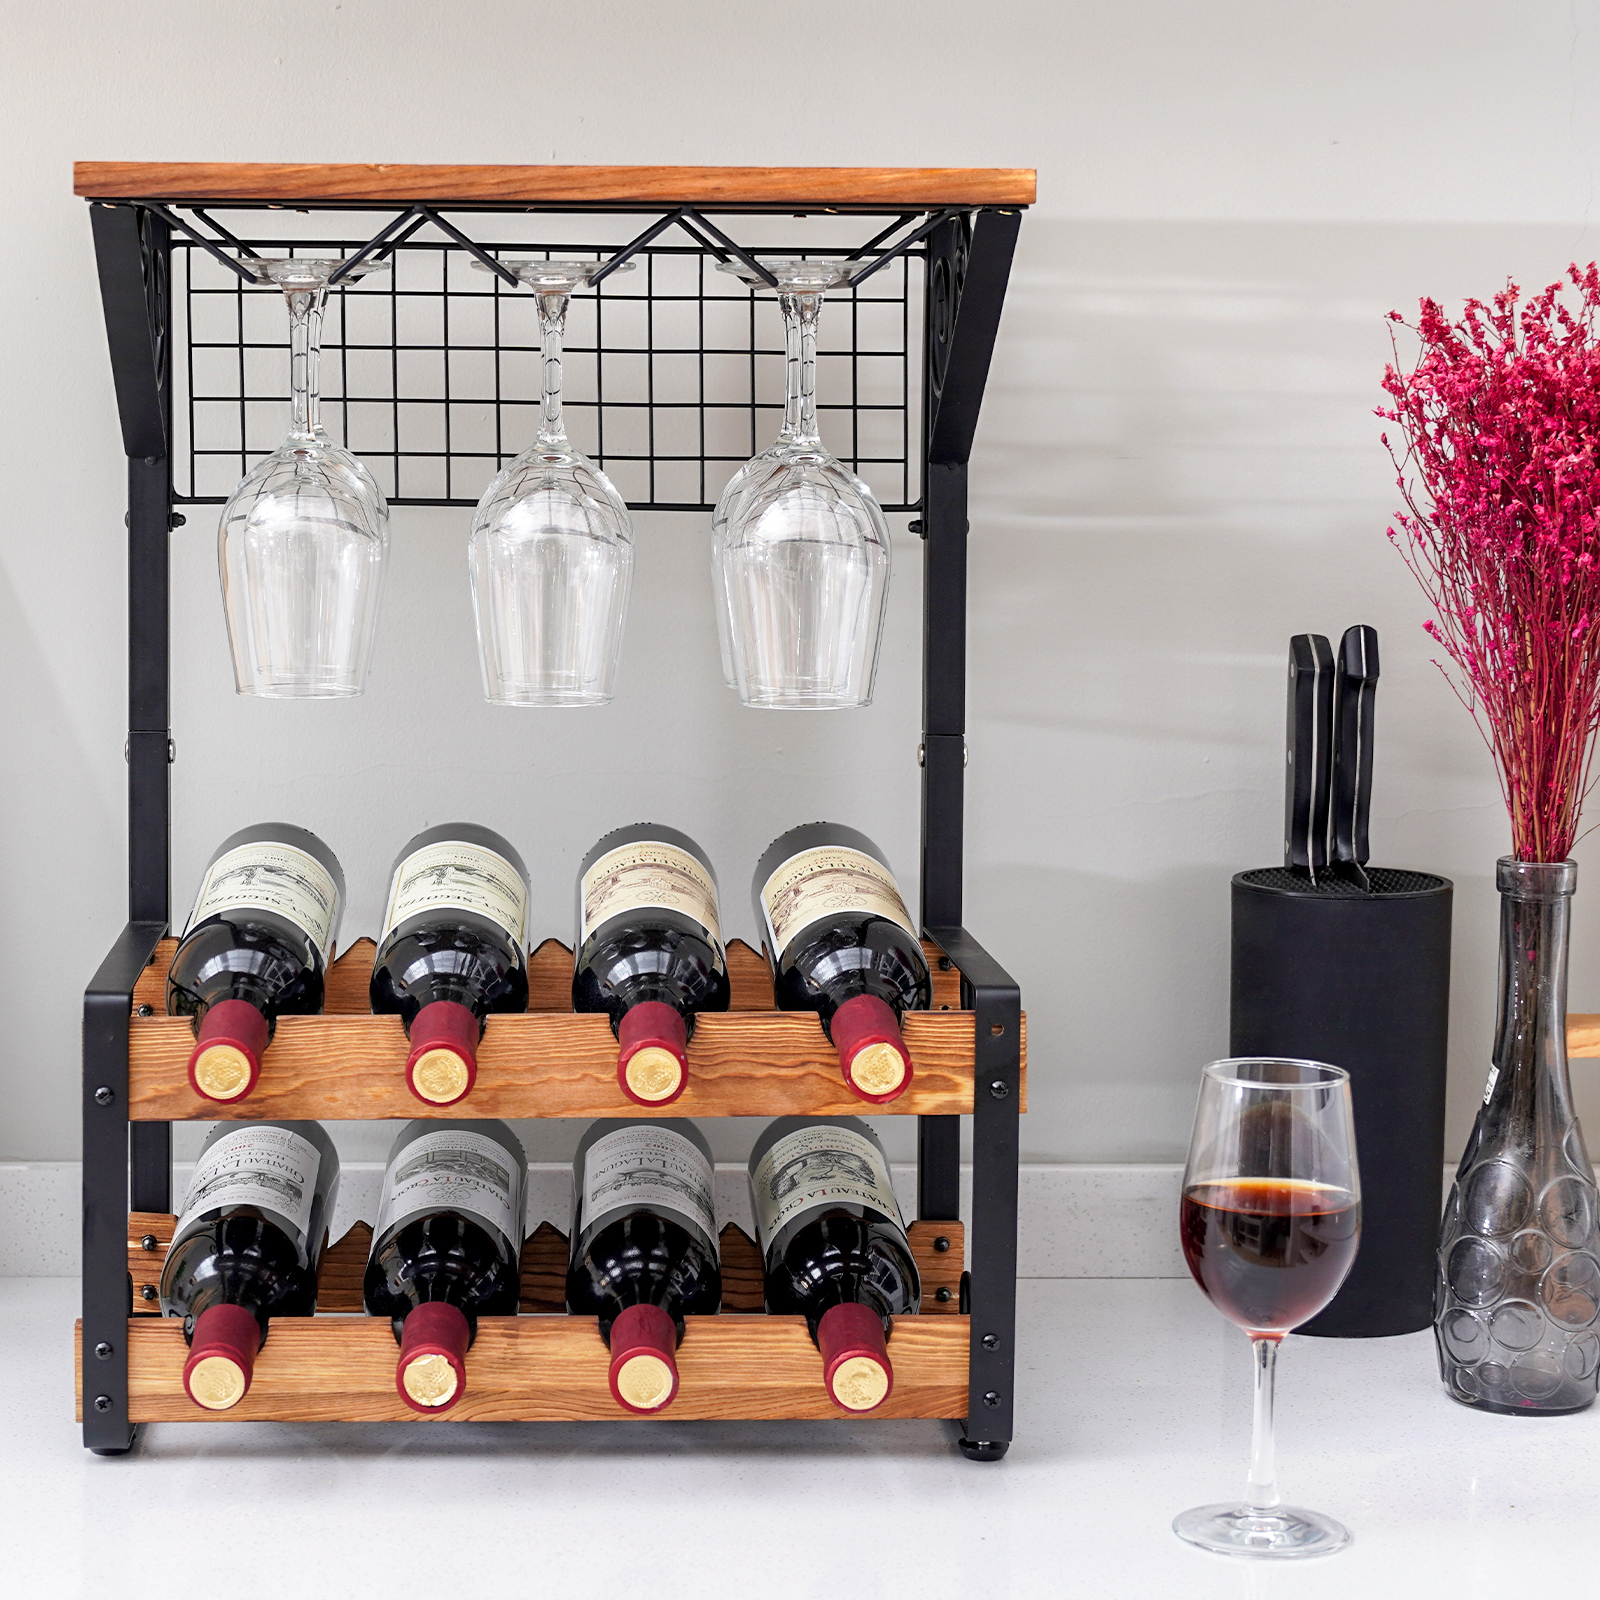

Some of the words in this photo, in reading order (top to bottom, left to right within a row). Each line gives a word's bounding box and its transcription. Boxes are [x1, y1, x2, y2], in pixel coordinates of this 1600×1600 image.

[453, 1176, 510, 1212] CHATEAU
[806, 1188, 827, 1200] LA
[829, 1187, 896, 1219] CHATEAU
[767, 1195, 804, 1237] CROIX
